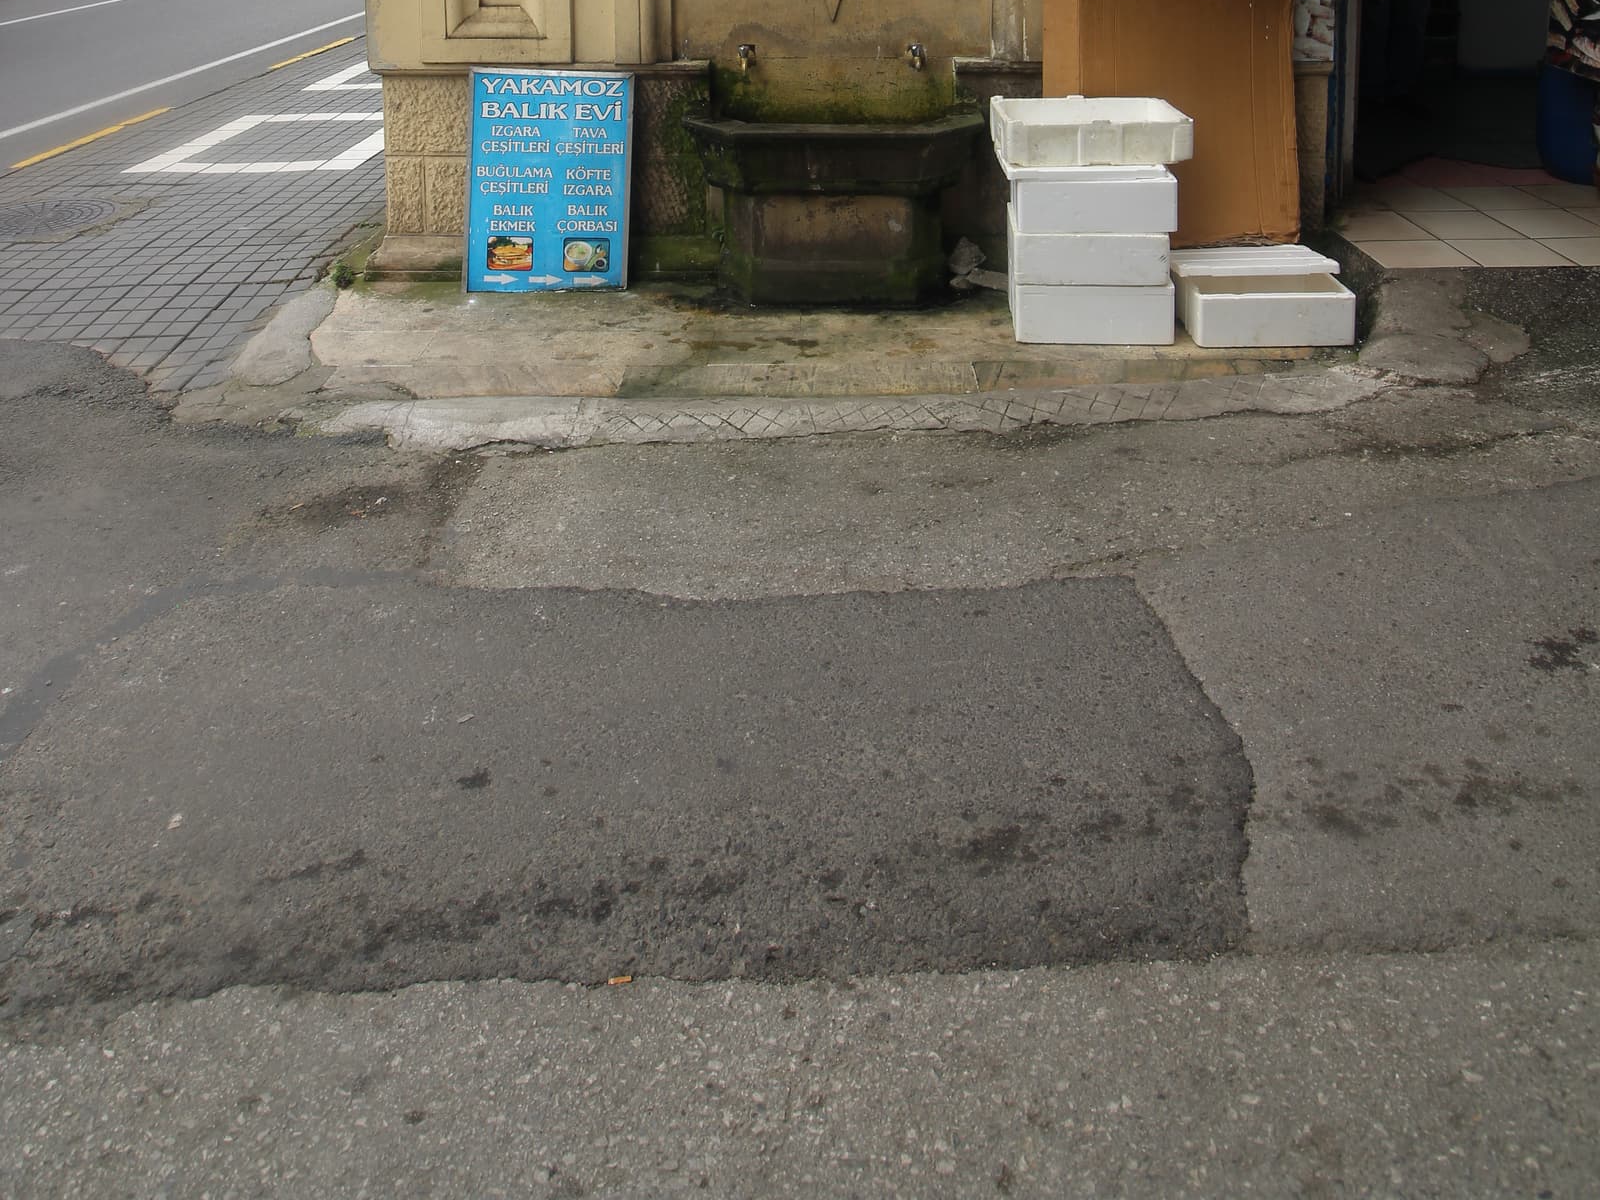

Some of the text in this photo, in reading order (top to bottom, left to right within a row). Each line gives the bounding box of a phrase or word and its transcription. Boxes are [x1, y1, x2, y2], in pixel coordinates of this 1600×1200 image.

[481, 77, 625, 97] YAKAMOZ
[481, 101, 623, 121] BALIK EVİ
[491, 125, 541, 137] IZGARA
[573, 127, 607, 139] TAVA
[481, 139, 550, 155] ÇEŞİTLERİ
[555, 141, 625, 157] ÇEŞİTLERİ
[476, 164, 553, 178] BUĞULAMA
[566, 166, 612, 180] KÖFTE
[480, 180, 549, 196] ÇEŞİTLERİ
[563, 184, 613, 196] IZGARA
[493, 204, 534, 216] BALIK
[567, 204, 608, 216] BALIK
[490, 220, 536, 232] EKMEK
[556, 220, 617, 234] ÇORBASI
